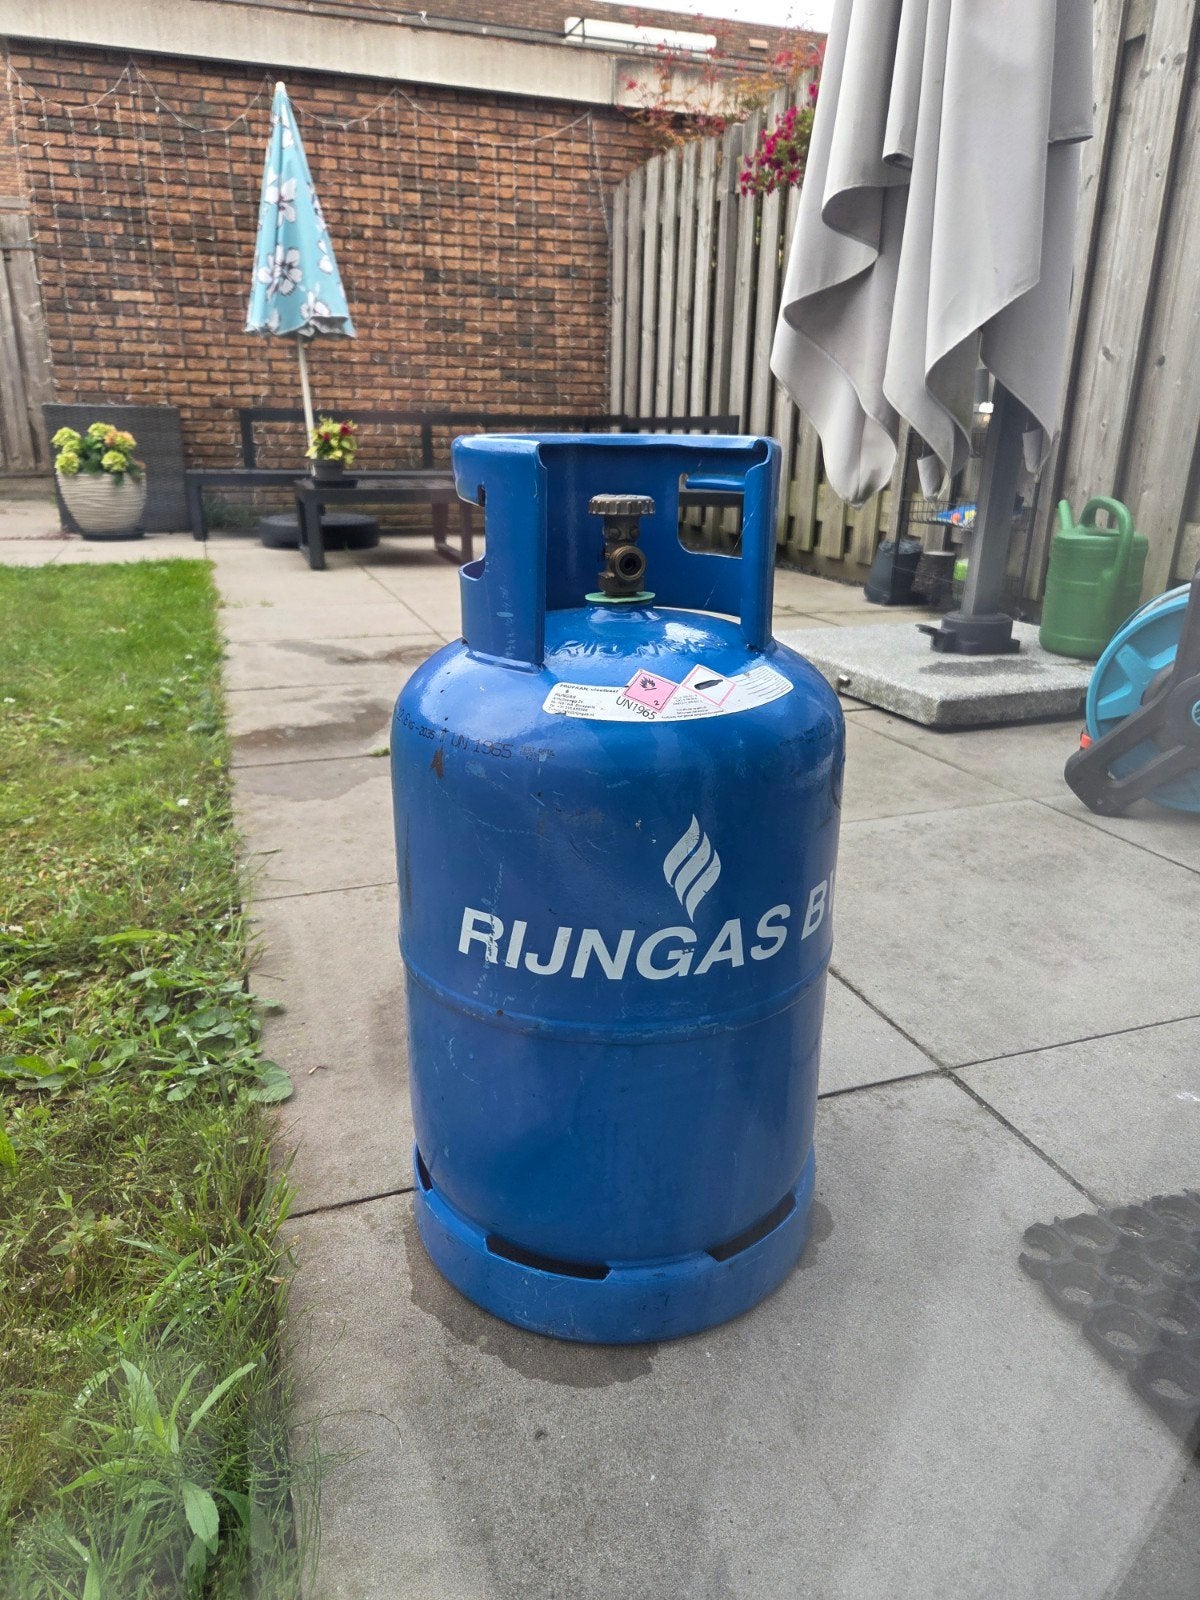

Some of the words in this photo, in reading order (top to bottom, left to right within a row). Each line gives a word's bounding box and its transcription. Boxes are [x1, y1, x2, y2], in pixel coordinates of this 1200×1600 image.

[615, 695, 658, 720] UN1965
[450, 735, 470, 751] UN
[473, 738, 514, 759] 1965
[457, 904, 791, 981] RIJNGAS
